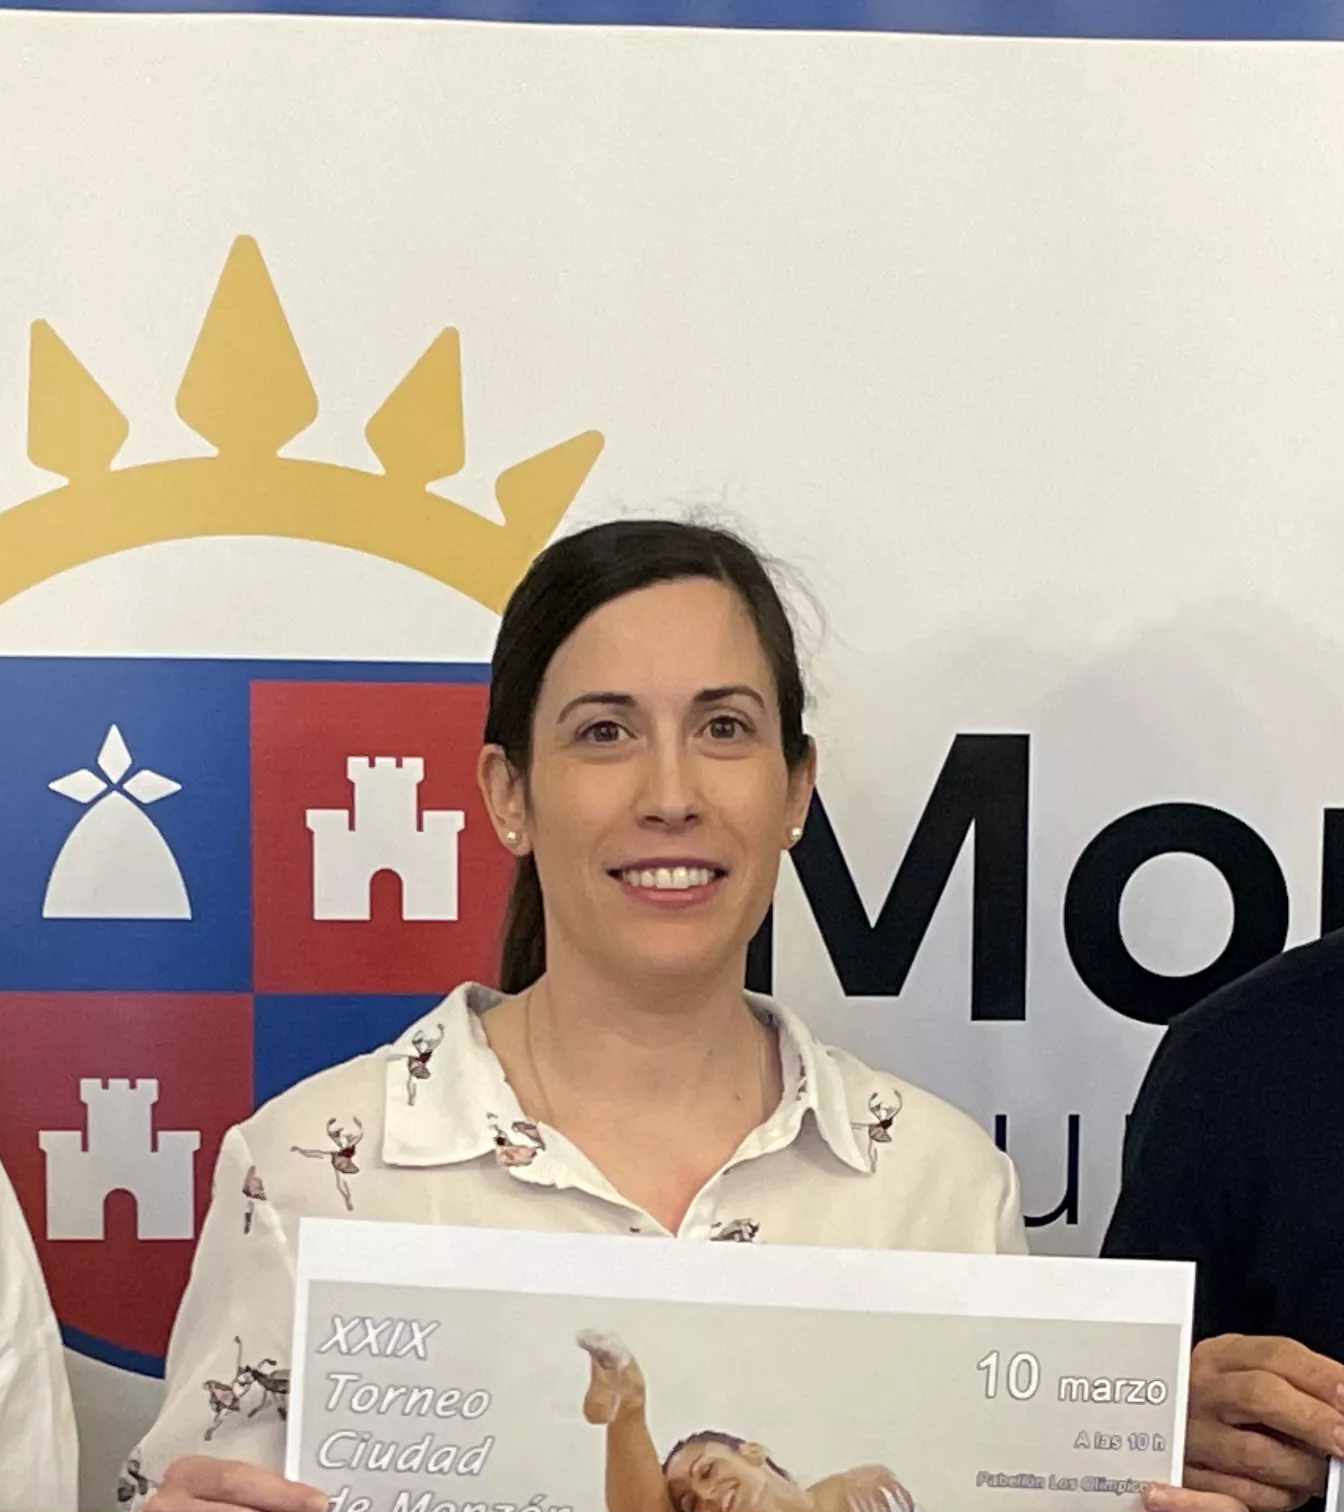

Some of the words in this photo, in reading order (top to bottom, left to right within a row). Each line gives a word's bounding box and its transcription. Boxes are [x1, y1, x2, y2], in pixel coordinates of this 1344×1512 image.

[320, 1314, 439, 1360] XXIX
[323, 1372, 492, 1419] Torneo
[977, 1350, 1040, 1400] 10
[1058, 1375, 1167, 1404] marzo
[317, 1430, 493, 1477] Ciudad
[1074, 1431, 1090, 1449] A
[1094, 1432, 1122, 1450] las
[1126, 1433, 1149, 1451] 10
[1152, 1433, 1165, 1451] h
[1048, 1474, 1078, 1491] Los
